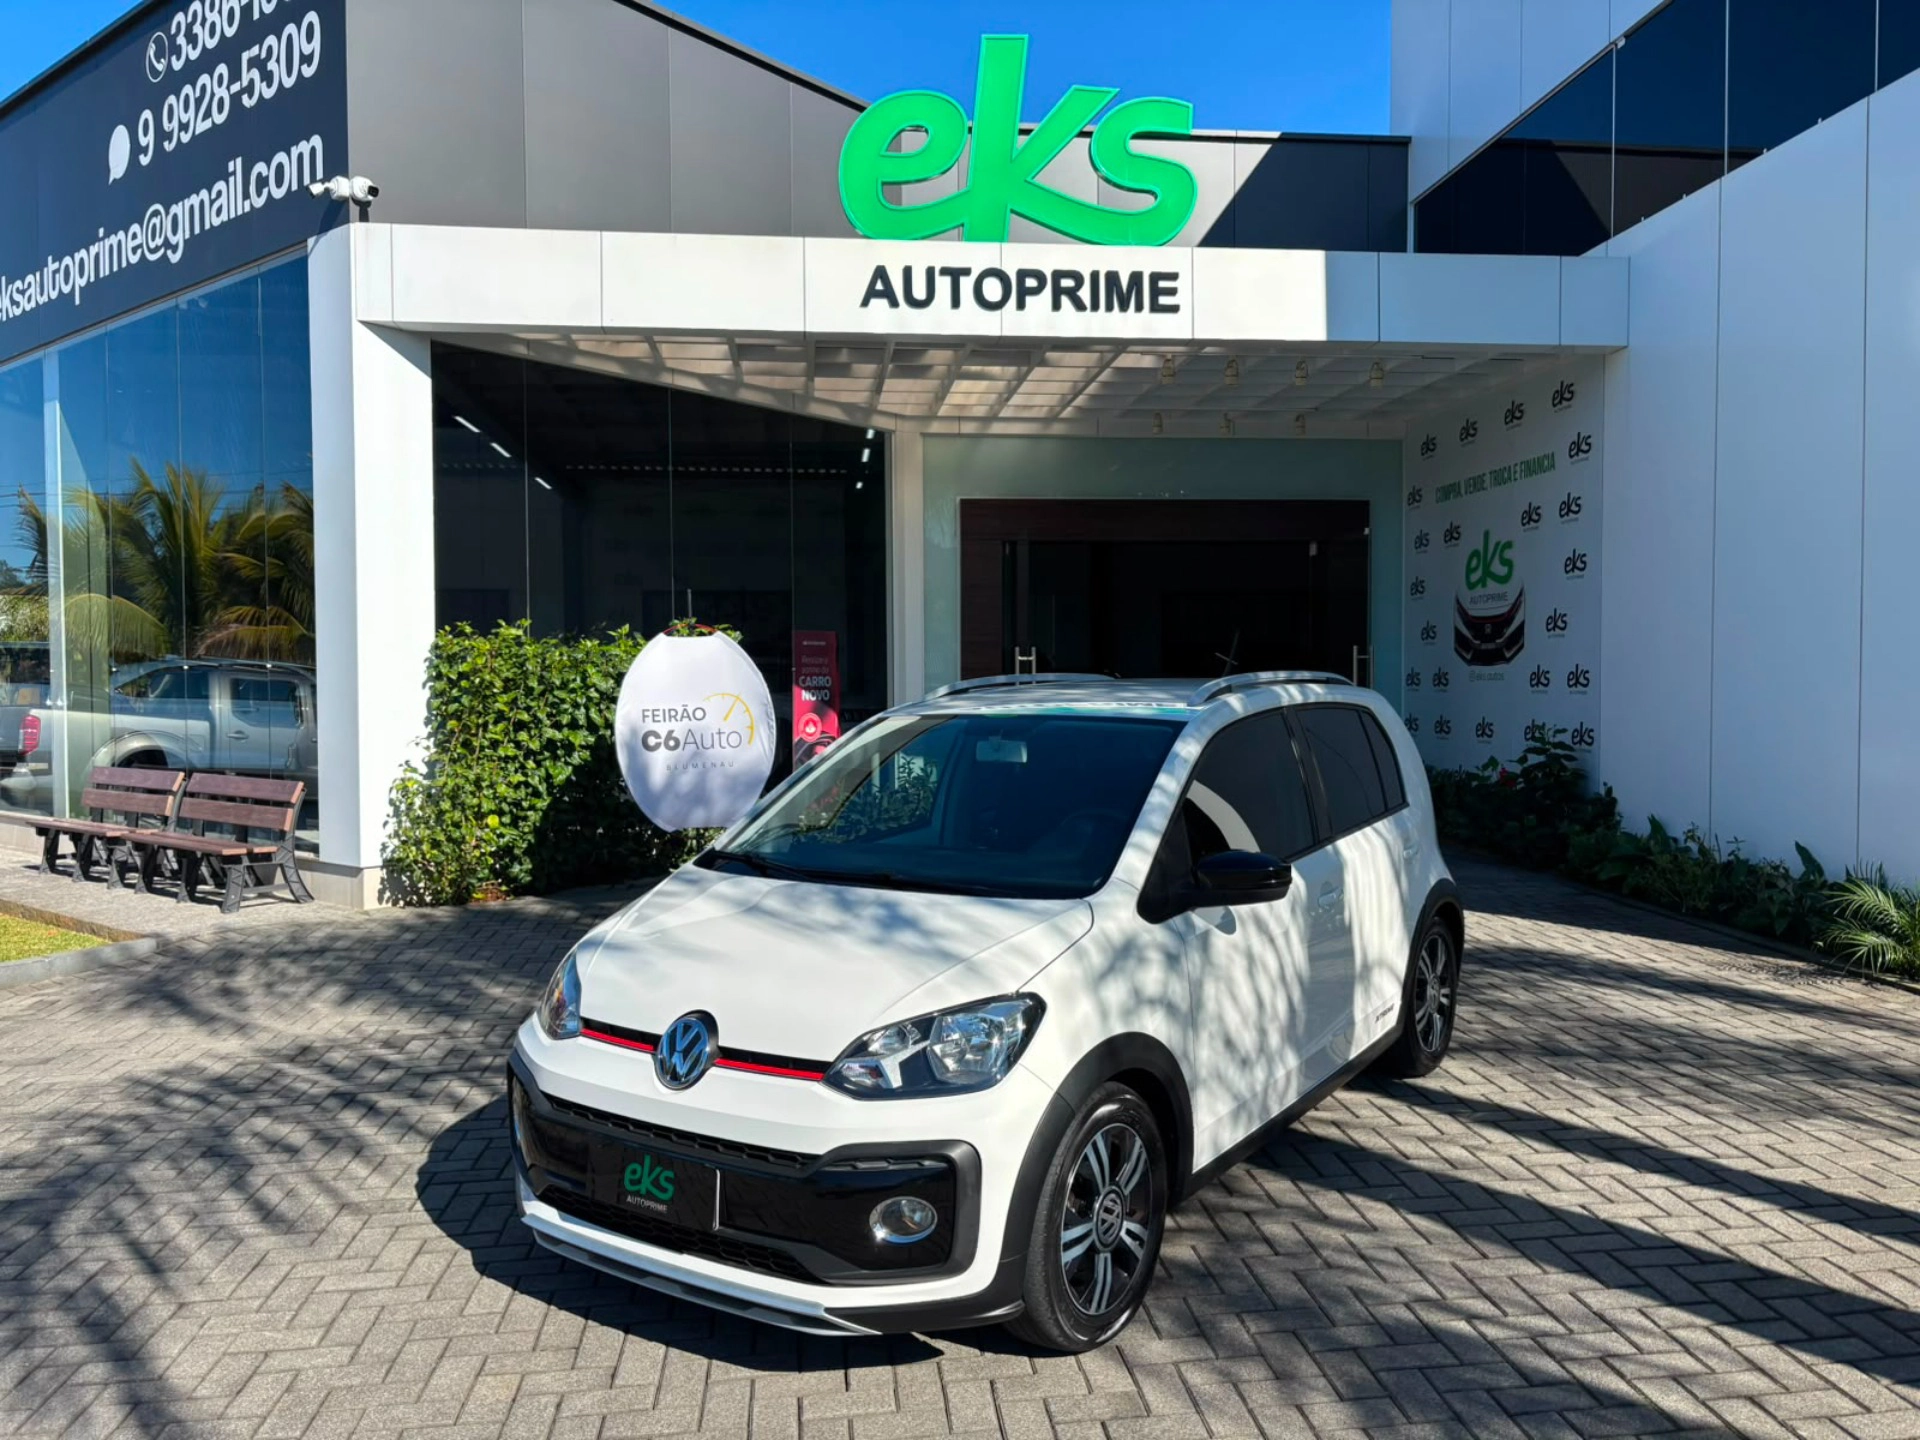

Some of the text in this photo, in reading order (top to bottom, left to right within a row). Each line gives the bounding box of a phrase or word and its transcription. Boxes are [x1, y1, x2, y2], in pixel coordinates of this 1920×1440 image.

[138, 11, 321, 166] 9 9928-5309
[839, 34, 1198, 247] eks
[0, 134, 324, 322] ksautoprime@gmail.com
[860, 265, 1180, 314] AUTOPRIME
[1552, 381, 1575, 407] eks
[1504, 401, 1524, 425] eks
[1458, 419, 1477, 442] eks
[1568, 432, 1591, 459] eks
[1519, 451, 1556, 479] FINANCIA
[1521, 502, 1541, 526] eks
[1558, 492, 1581, 518] eks
[1443, 522, 1461, 544] eks
[1465, 529, 1514, 590] eks
[1564, 549, 1587, 574] eks
[1469, 591, 1508, 605] AUTOPRIME
[1546, 608, 1567, 632] eks
[799, 676, 831, 687] CARRO
[1530, 664, 1549, 688] eks
[1567, 664, 1590, 688] eks
[801, 689, 829, 701] NOVO
[641, 704, 707, 723] FEIRÃO
[1475, 716, 1494, 738] eks
[1571, 721, 1594, 746] eks
[666, 760, 735, 771] BLUMENAU
[624, 1153, 675, 1200] eks
[626, 1195, 668, 1213] AUTOPRIME
